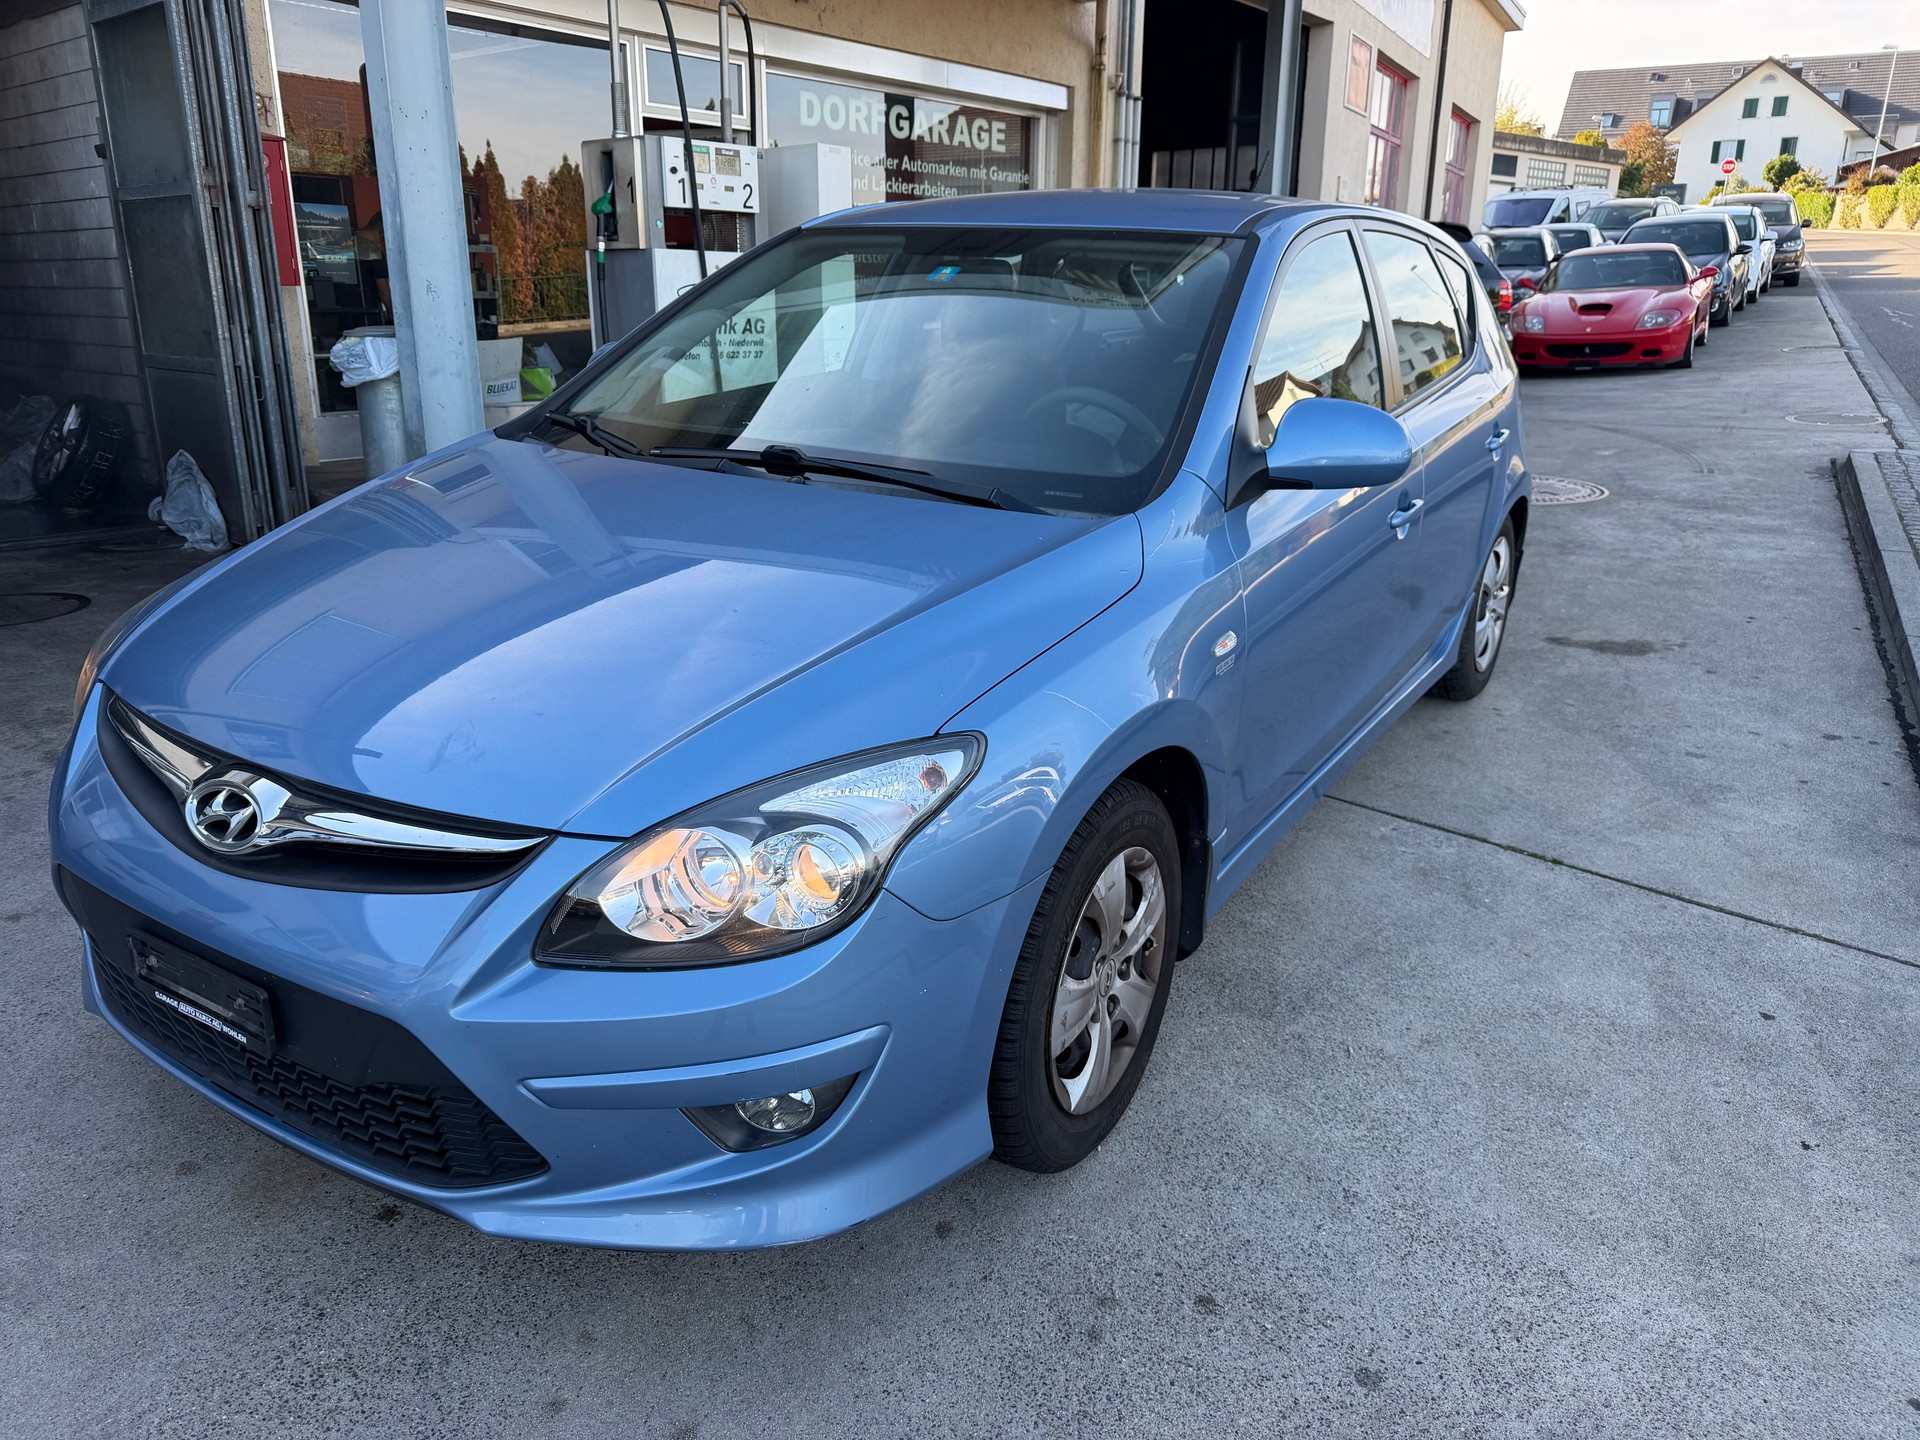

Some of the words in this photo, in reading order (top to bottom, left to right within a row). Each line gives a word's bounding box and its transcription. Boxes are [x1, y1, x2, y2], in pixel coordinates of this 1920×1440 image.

[800, 90, 1007, 153] DORFGARAGE
[872, 153, 899, 170] aller
[902, 155, 968, 178] Automarken
[970, 164, 988, 180] mit
[989, 166, 1030, 184] Garantie
[626, 176, 635, 204] 1
[677, 177, 687, 204] 1
[742, 183, 754, 209] 2
[872, 176, 958, 198] Lackierarbeiten
[742, 317, 766, 335] AG
[726, 350, 740, 359] 622
[742, 350, 752, 359] 37
[753, 350, 764, 359] 37
[729, 339, 764, 348] Niederwil
[486, 381, 518, 395] BLUEKAT
[154, 991, 179, 1008] GARAGE
[180, 1003, 196, 1017] AUTO
[221, 1024, 247, 1044] WOHLEN
